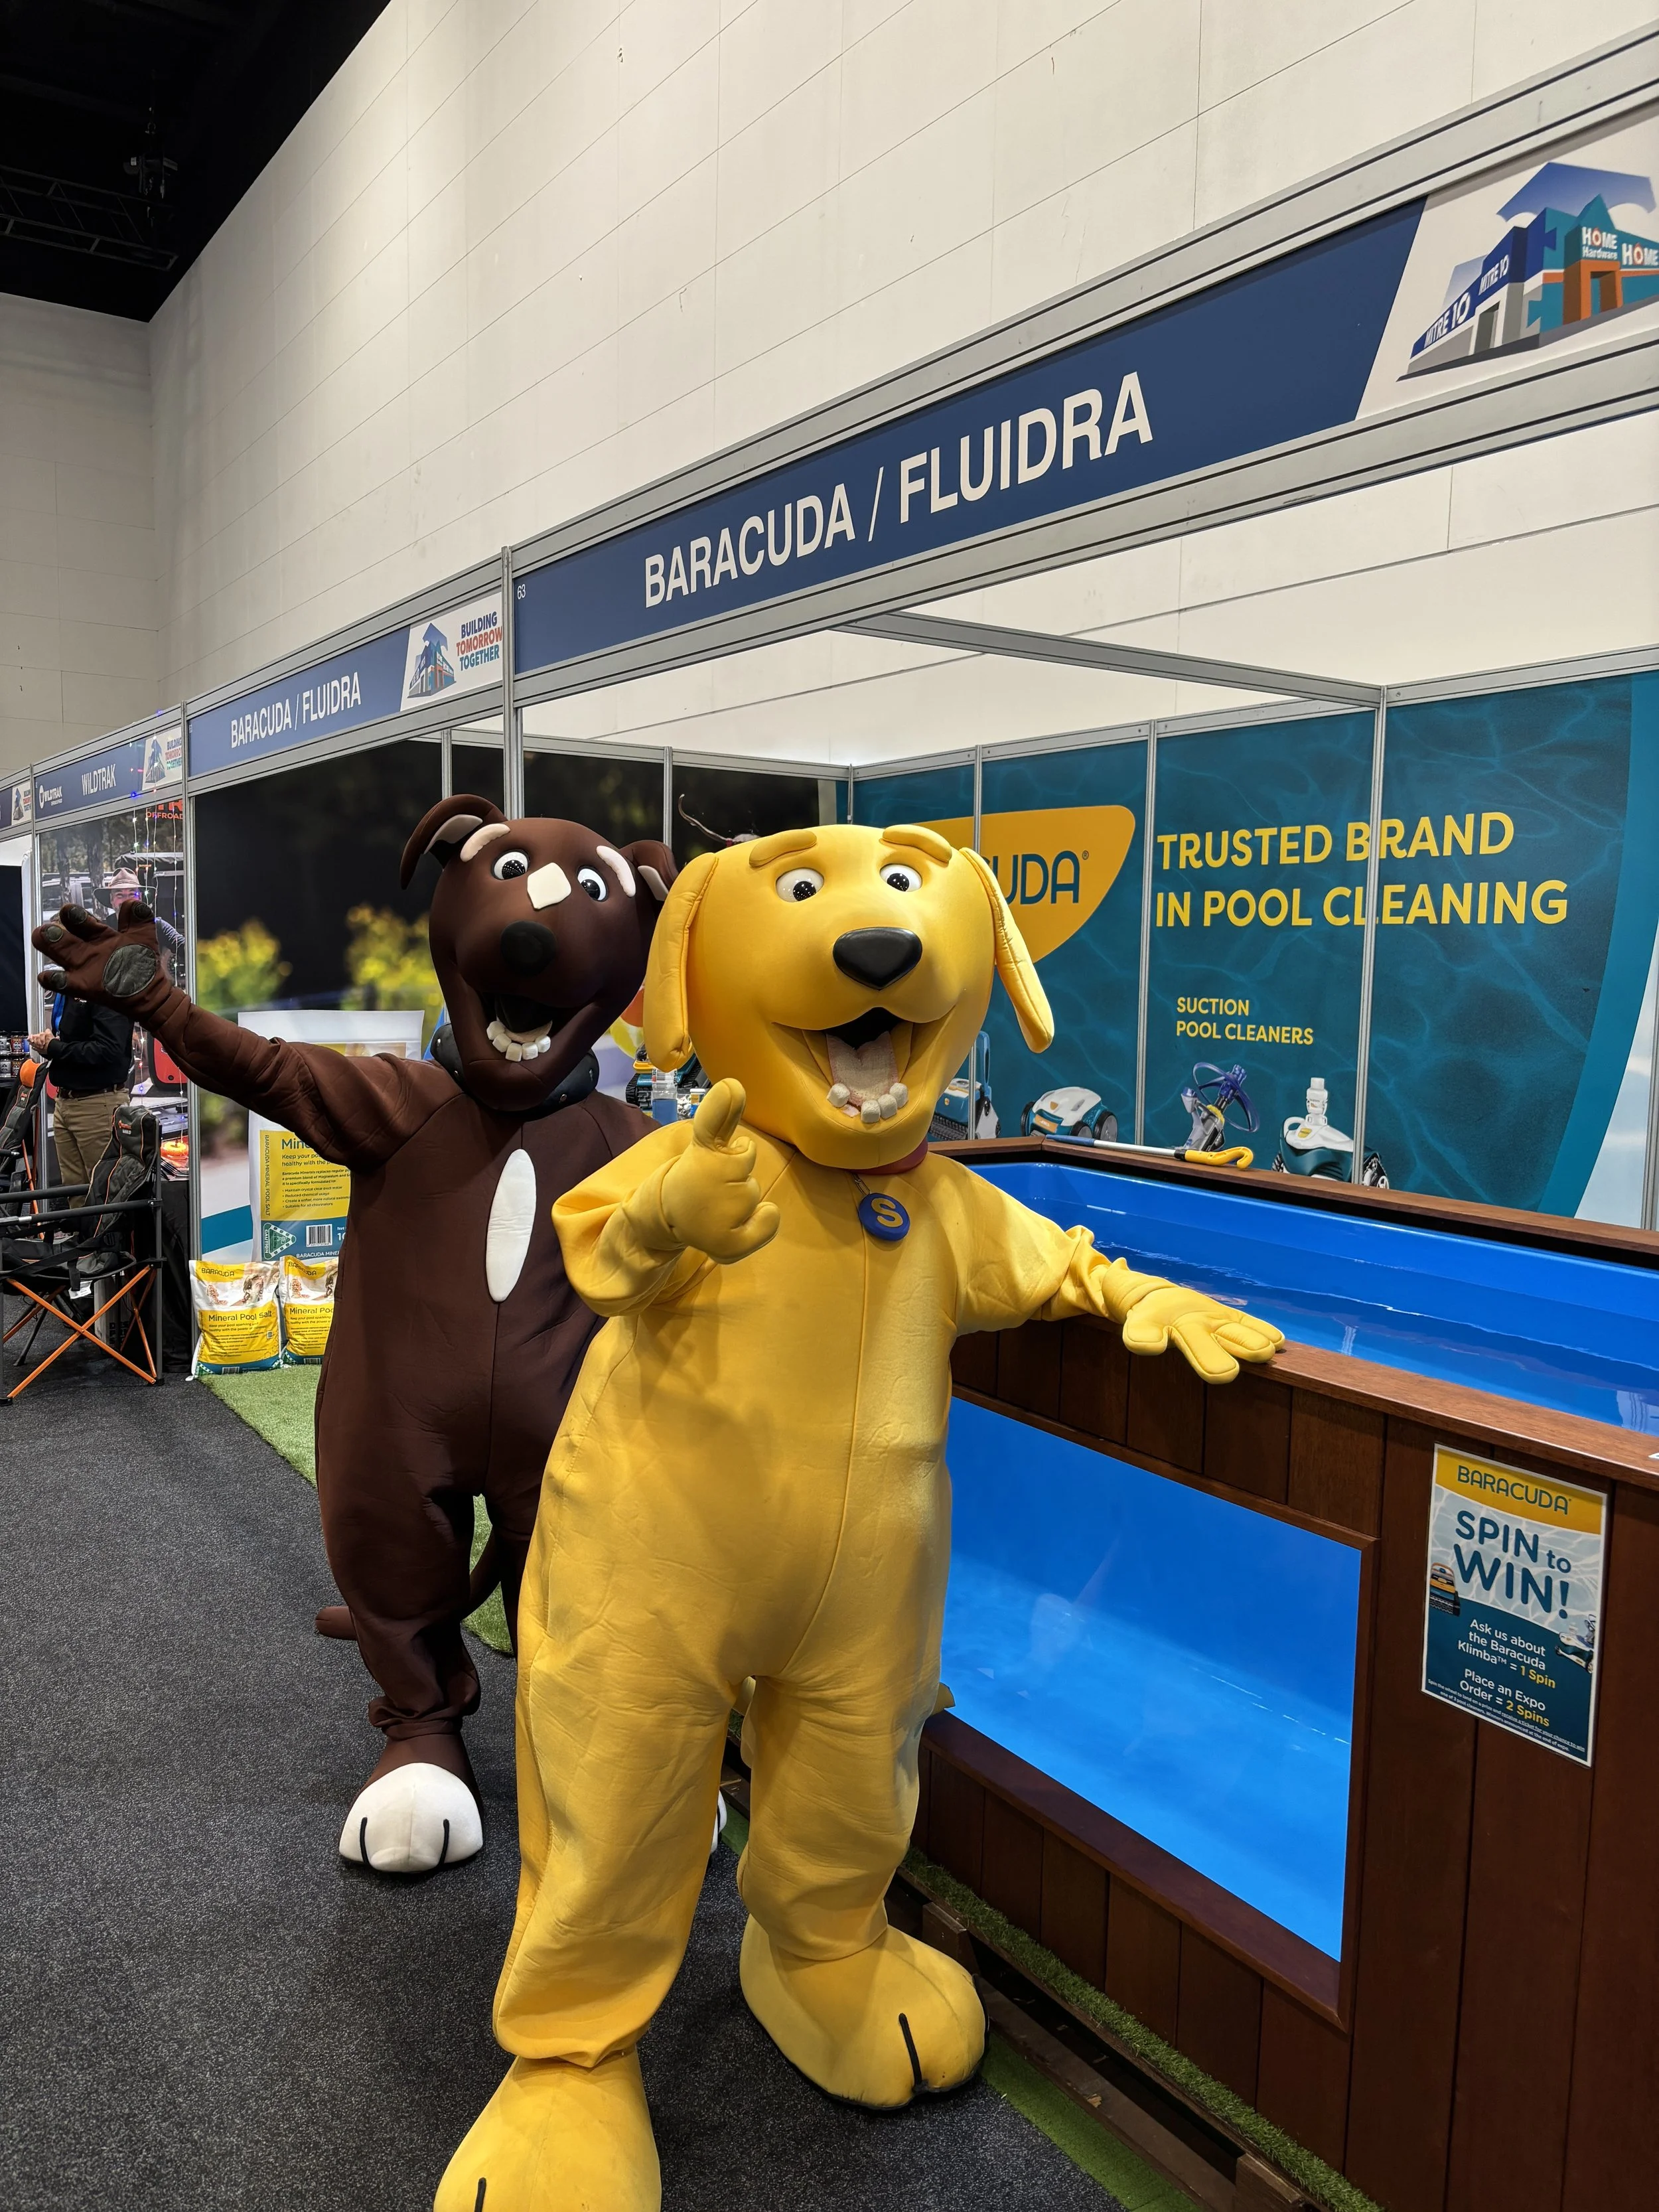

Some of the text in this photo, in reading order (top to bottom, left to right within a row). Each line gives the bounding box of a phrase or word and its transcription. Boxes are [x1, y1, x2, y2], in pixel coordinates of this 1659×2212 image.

[1582, 226, 1618, 250] HOME
[1582, 246, 1618, 260] Hardware
[1622, 243, 1659, 266] HOME
[1479, 255, 1509, 295] MITRE 10
[1423, 292, 1471, 349] MITRE 10
[644, 482, 855, 609] BARACUDA
[900, 370, 1153, 524] FLUIDRA
[517, 583, 526, 600] 63
[456, 626, 503, 656] TOMORROW
[461, 611, 498, 639] BUILDING
[459, 644, 500, 672] TOGETHER
[231, 697, 292, 749] BARACUDA
[302, 672, 362, 725] FLUIDRA
[82, 763, 117, 796] WILDTRAK
[1157, 811, 1514, 870] TRUSTED BRAND
[1156, 879, 1568, 927] IN POOL CLEANING
[1177, 997, 1250, 1016] SUCTION
[1177, 1021, 1314, 1045] POOL CLEANERS
[871, 1197, 903, 1228] S
[1457, 1465, 1569, 1515] BARACUDA
[1455, 1510, 1571, 1574] SPIN to
[1453, 1544, 1569, 1619] WIN!
[1469, 1631, 1546, 1670] the Baracuda
[1470, 1619, 1546, 1657] Ask us about
[1465, 1668, 1546, 1711] Place an Expo
[1520, 1665, 1526, 1676] 1
[1528, 1669, 1555, 1688] Spin
[1460, 1680, 1550, 1727] Order = 2 Spins
